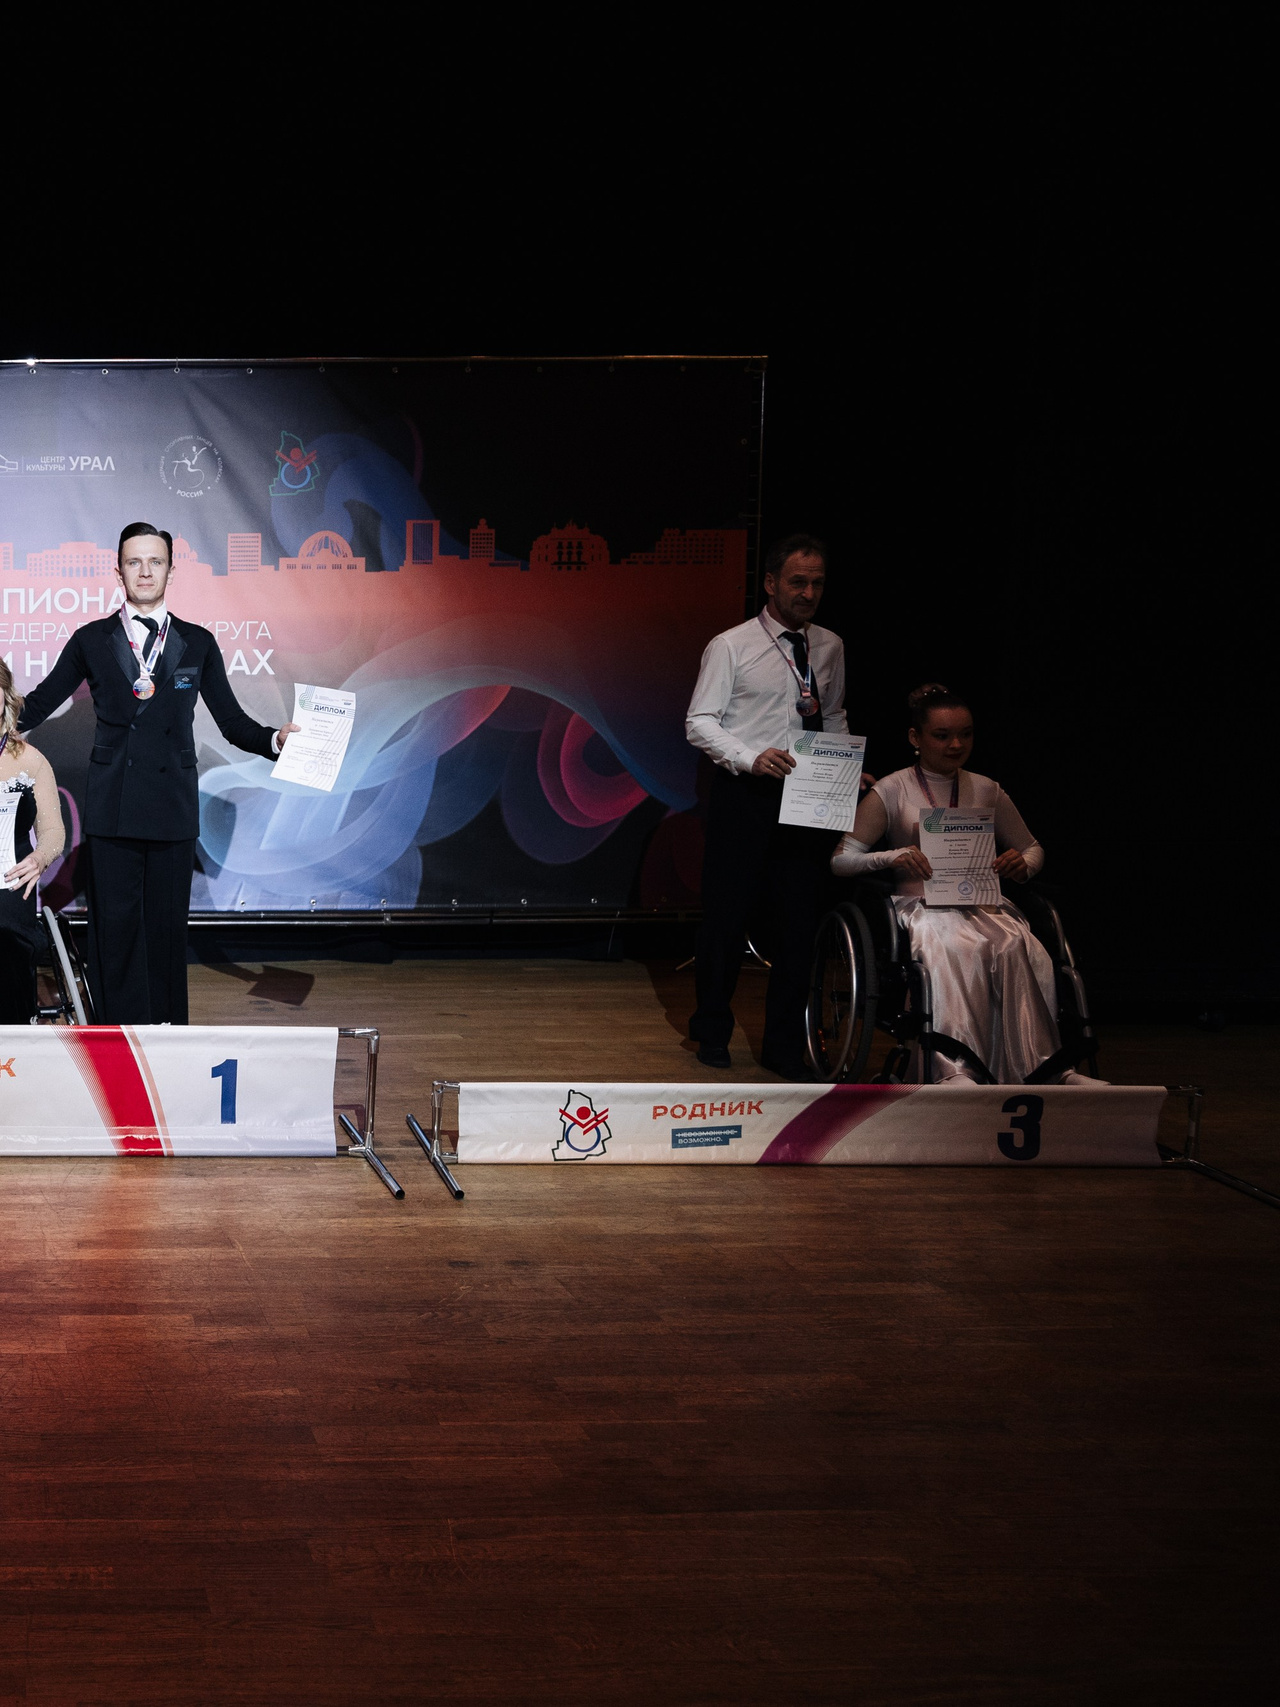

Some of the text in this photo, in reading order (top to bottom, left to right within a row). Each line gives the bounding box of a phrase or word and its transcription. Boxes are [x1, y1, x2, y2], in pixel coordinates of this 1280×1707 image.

[40, 456, 66, 464] ЦЕНТР
[68, 456, 116, 471] УРАЛ
[26, 464, 66, 472] КУЛЬТУРЫ
[176, 489, 204, 498] РОССИЯ
[313, 704, 346, 715] ДИПЛОМ
[813, 748, 853, 758] ДИПЛОМ
[211, 1059, 238, 1124] 1
[652, 1100, 765, 1120] РОДНИК
[997, 1094, 1044, 1161] 3
[678, 1136, 723, 1145] ВОЗМОЖНО.
